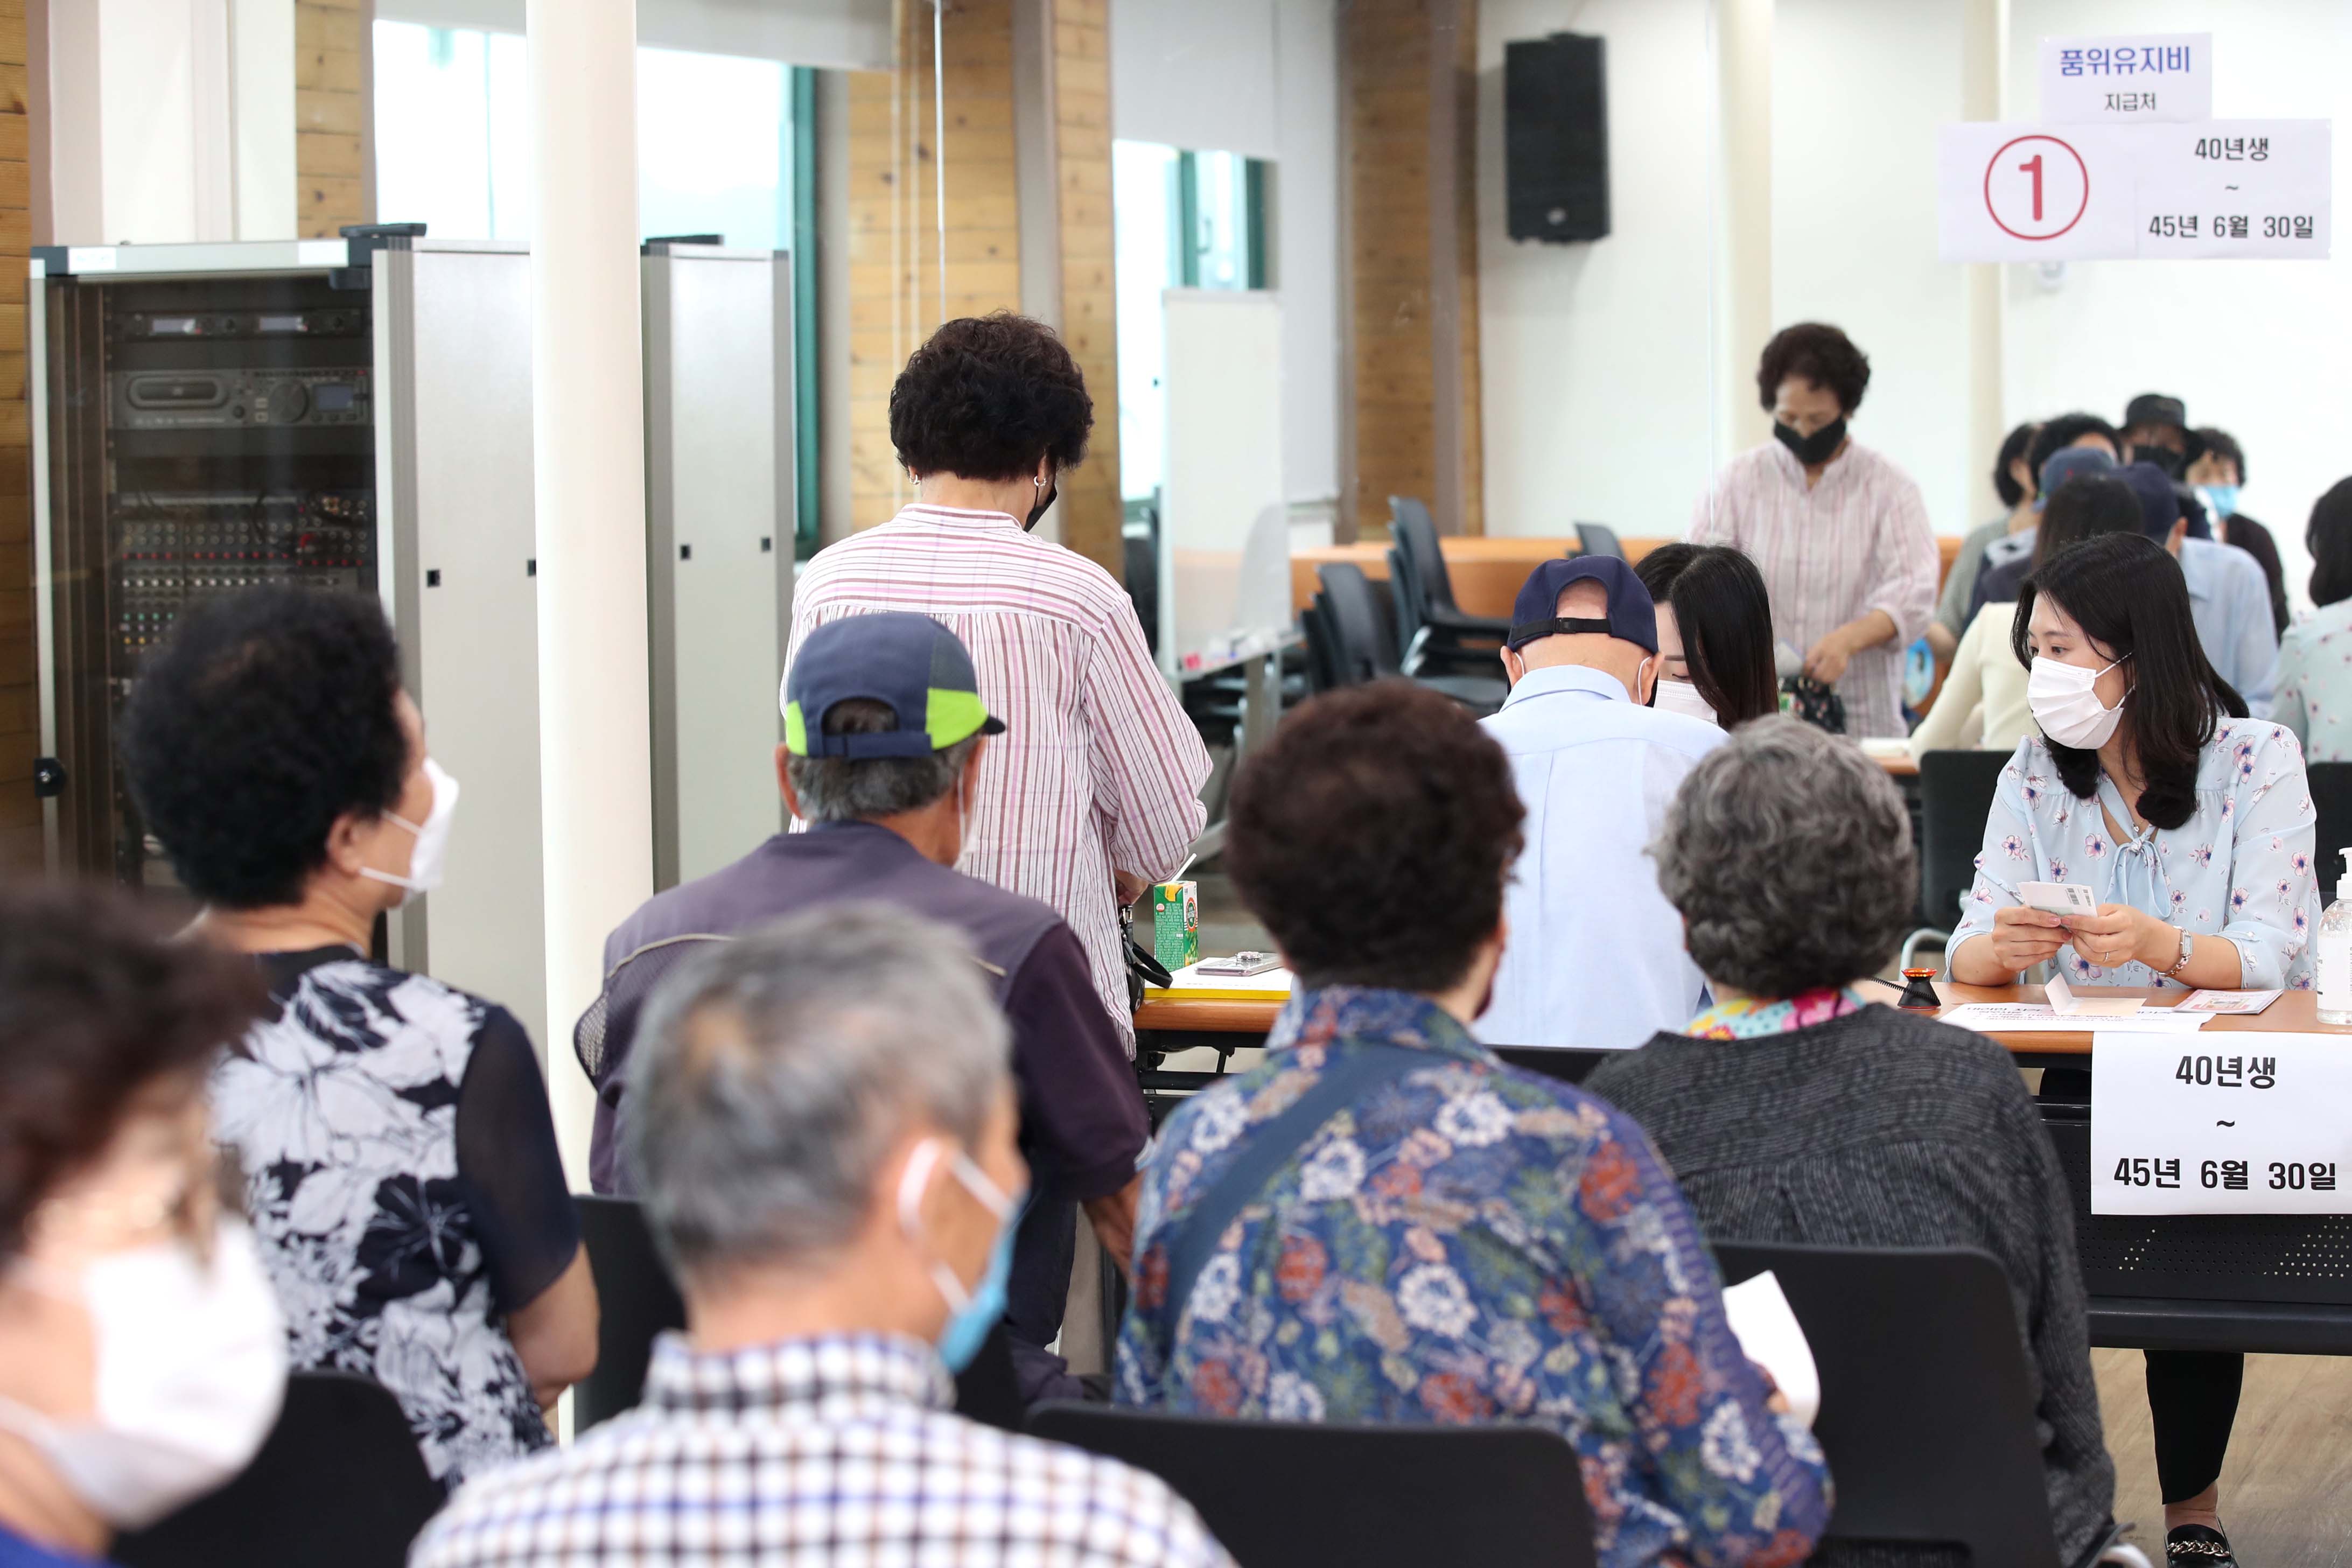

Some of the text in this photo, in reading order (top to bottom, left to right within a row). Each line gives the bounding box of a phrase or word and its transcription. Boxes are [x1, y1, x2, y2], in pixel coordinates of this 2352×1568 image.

[2060, 45, 2190, 76] 품위유지비
[2104, 92, 2156, 111] 지급처
[2194, 137, 2269, 162] 40년생
[2148, 215, 2314, 239] 45년 6월 30일
[2175, 1055, 2276, 1089] 40년생
[2113, 1157, 2336, 1191] 45년 6월 30일
